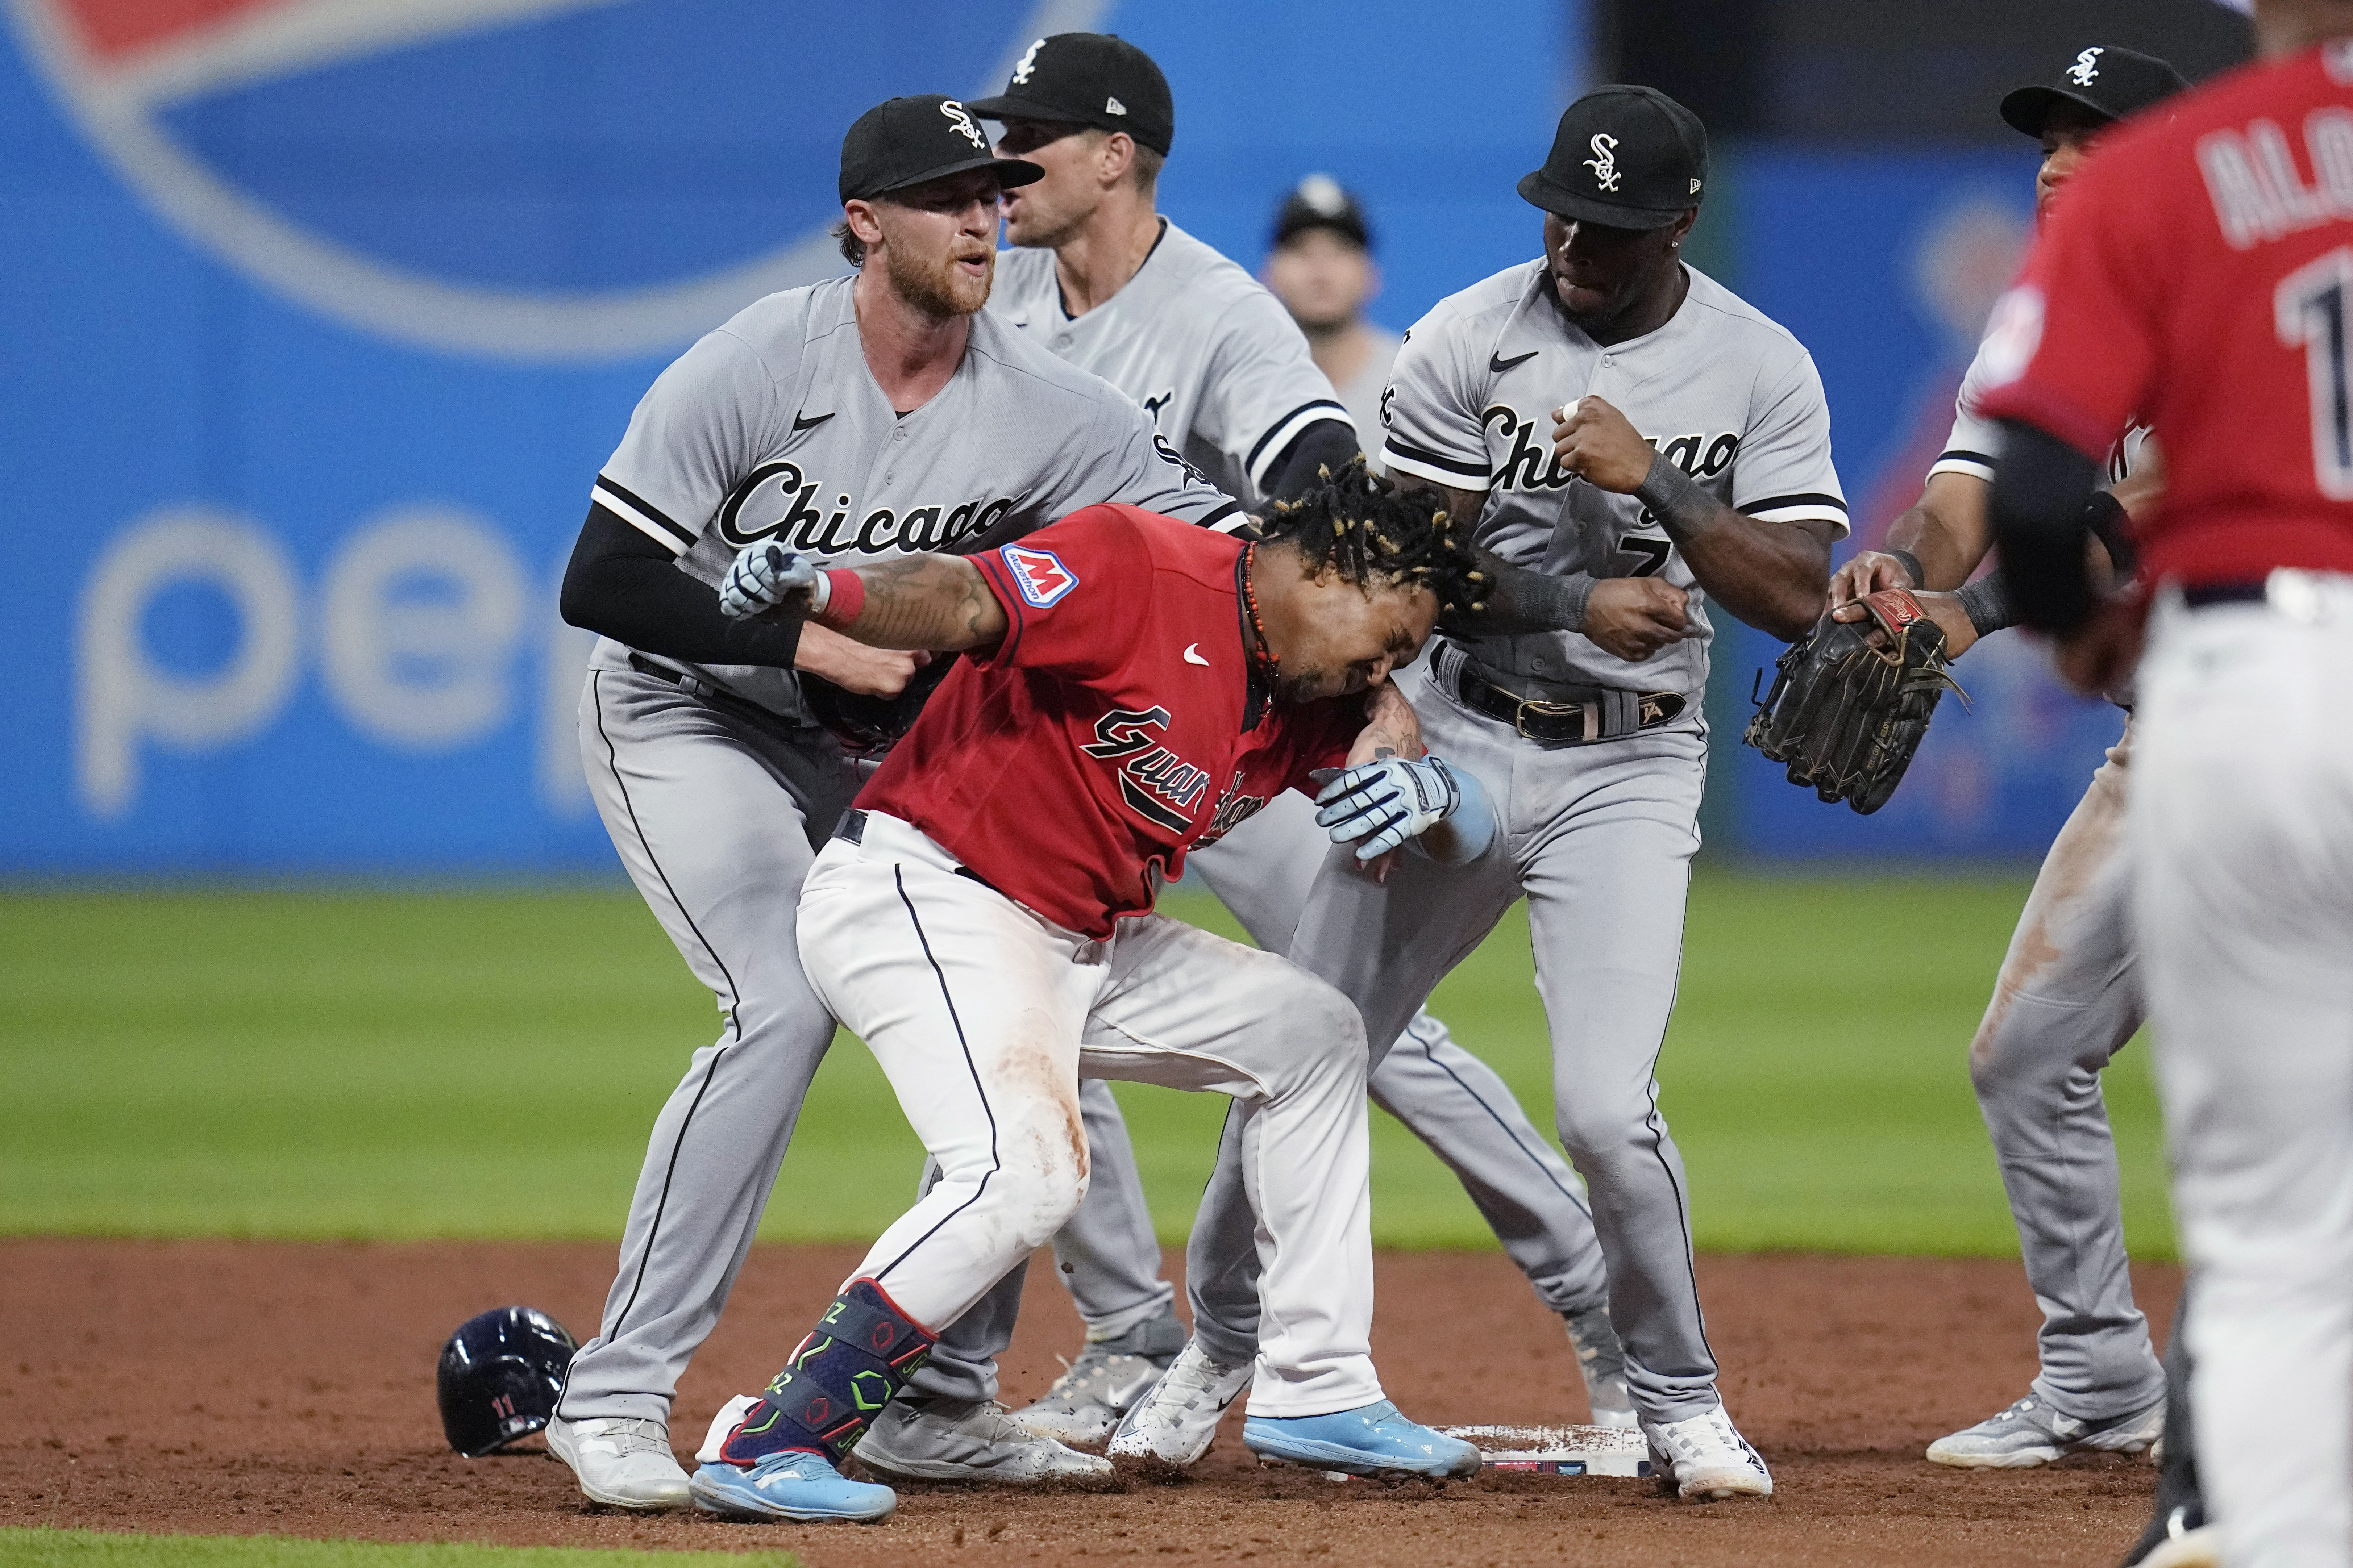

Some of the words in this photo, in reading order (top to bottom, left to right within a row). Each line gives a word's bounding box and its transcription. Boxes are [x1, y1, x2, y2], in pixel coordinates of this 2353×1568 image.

[940, 100, 985, 149] Sox
[1583, 133, 1621, 192] Sox
[1008, 553, 1039, 600] Marathon
[491, 1393, 515, 1419] 11
